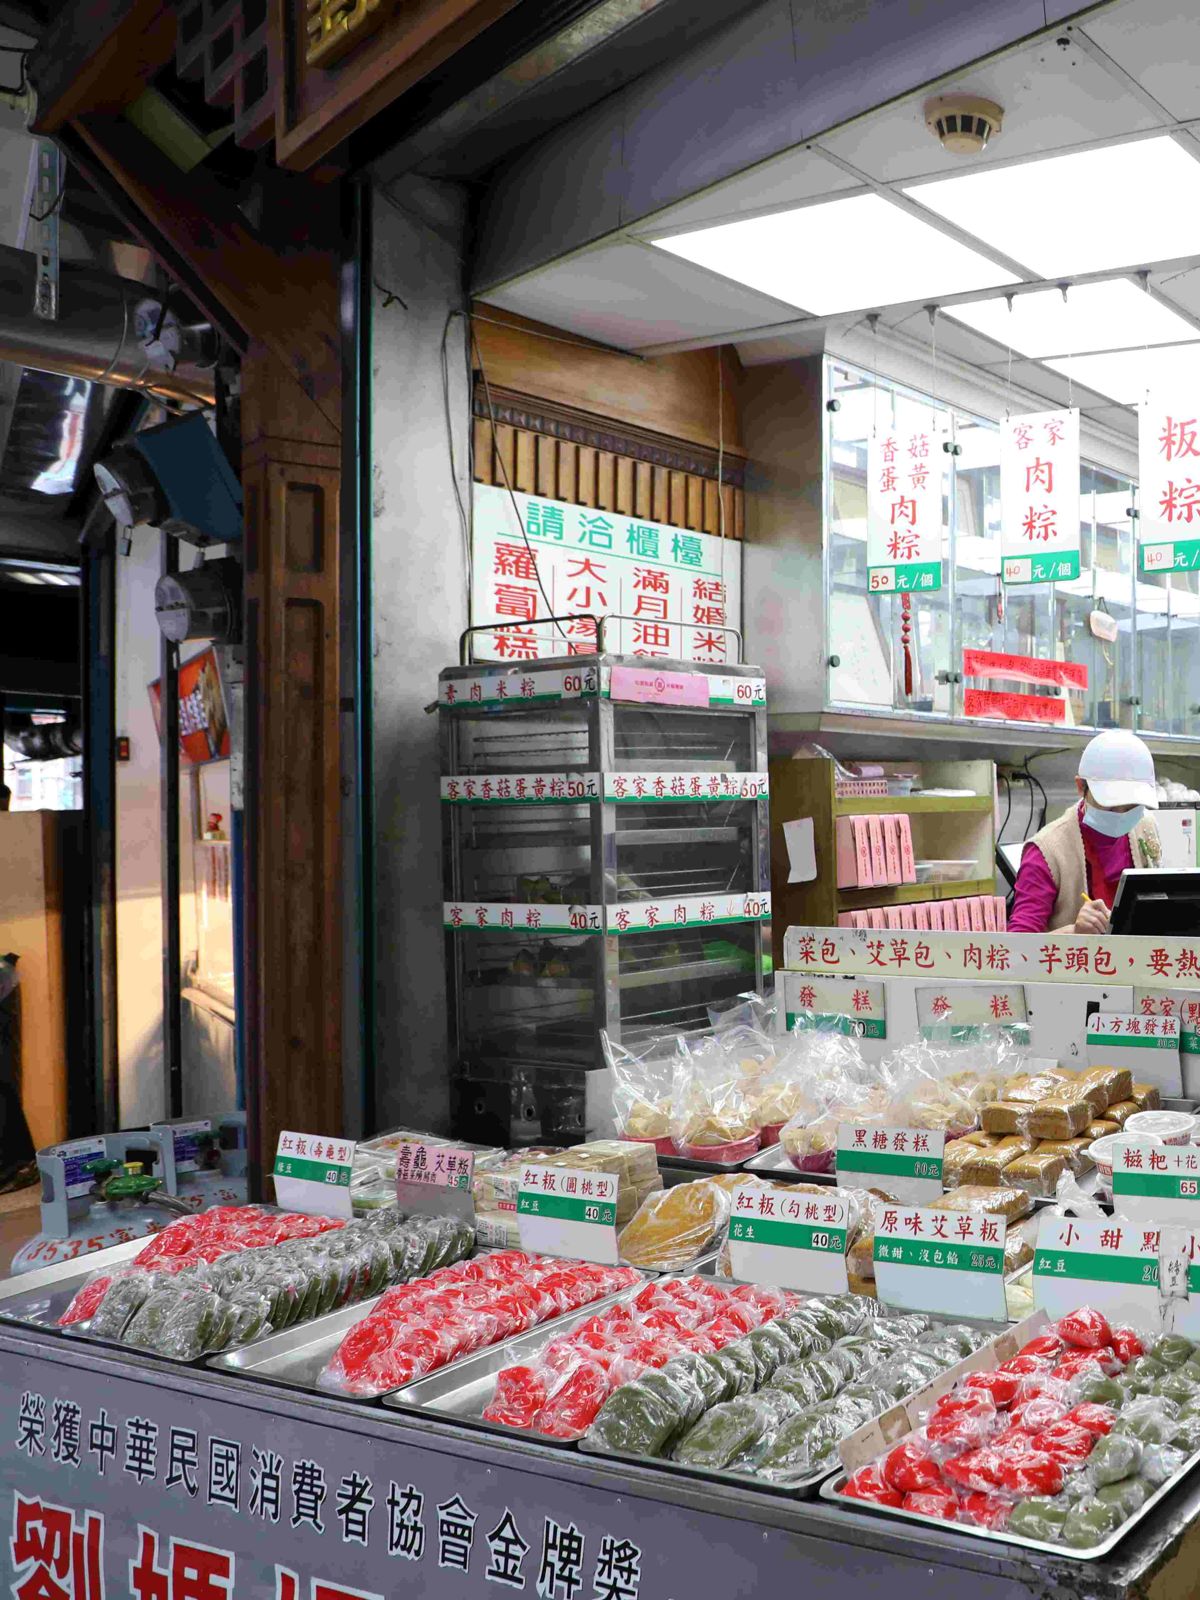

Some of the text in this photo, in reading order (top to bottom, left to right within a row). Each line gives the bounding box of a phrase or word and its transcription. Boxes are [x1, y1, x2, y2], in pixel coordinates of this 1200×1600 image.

[879, 433, 931, 463] 香菇
[1012, 418, 1066, 451] 客家
[1021, 456, 1058, 542] 肉粽
[886, 495, 921, 561] 肉粽
[691, 577, 728, 663] 結婚米
[737, 684, 765, 701] 60元
[567, 779, 598, 798] 50元
[450, 905, 601, 930] 客家肉粽 40元
[615, 901, 716, 931] 客家肉粽
[798, 984, 874, 1013] 發糕
[1091, 1016, 1178, 1037] 小方塊發糕
[851, 1128, 930, 1153] 黑糖發糕
[733, 1223, 755, 1239] 花生
[1038, 1257, 1067, 1274] 紅豆
